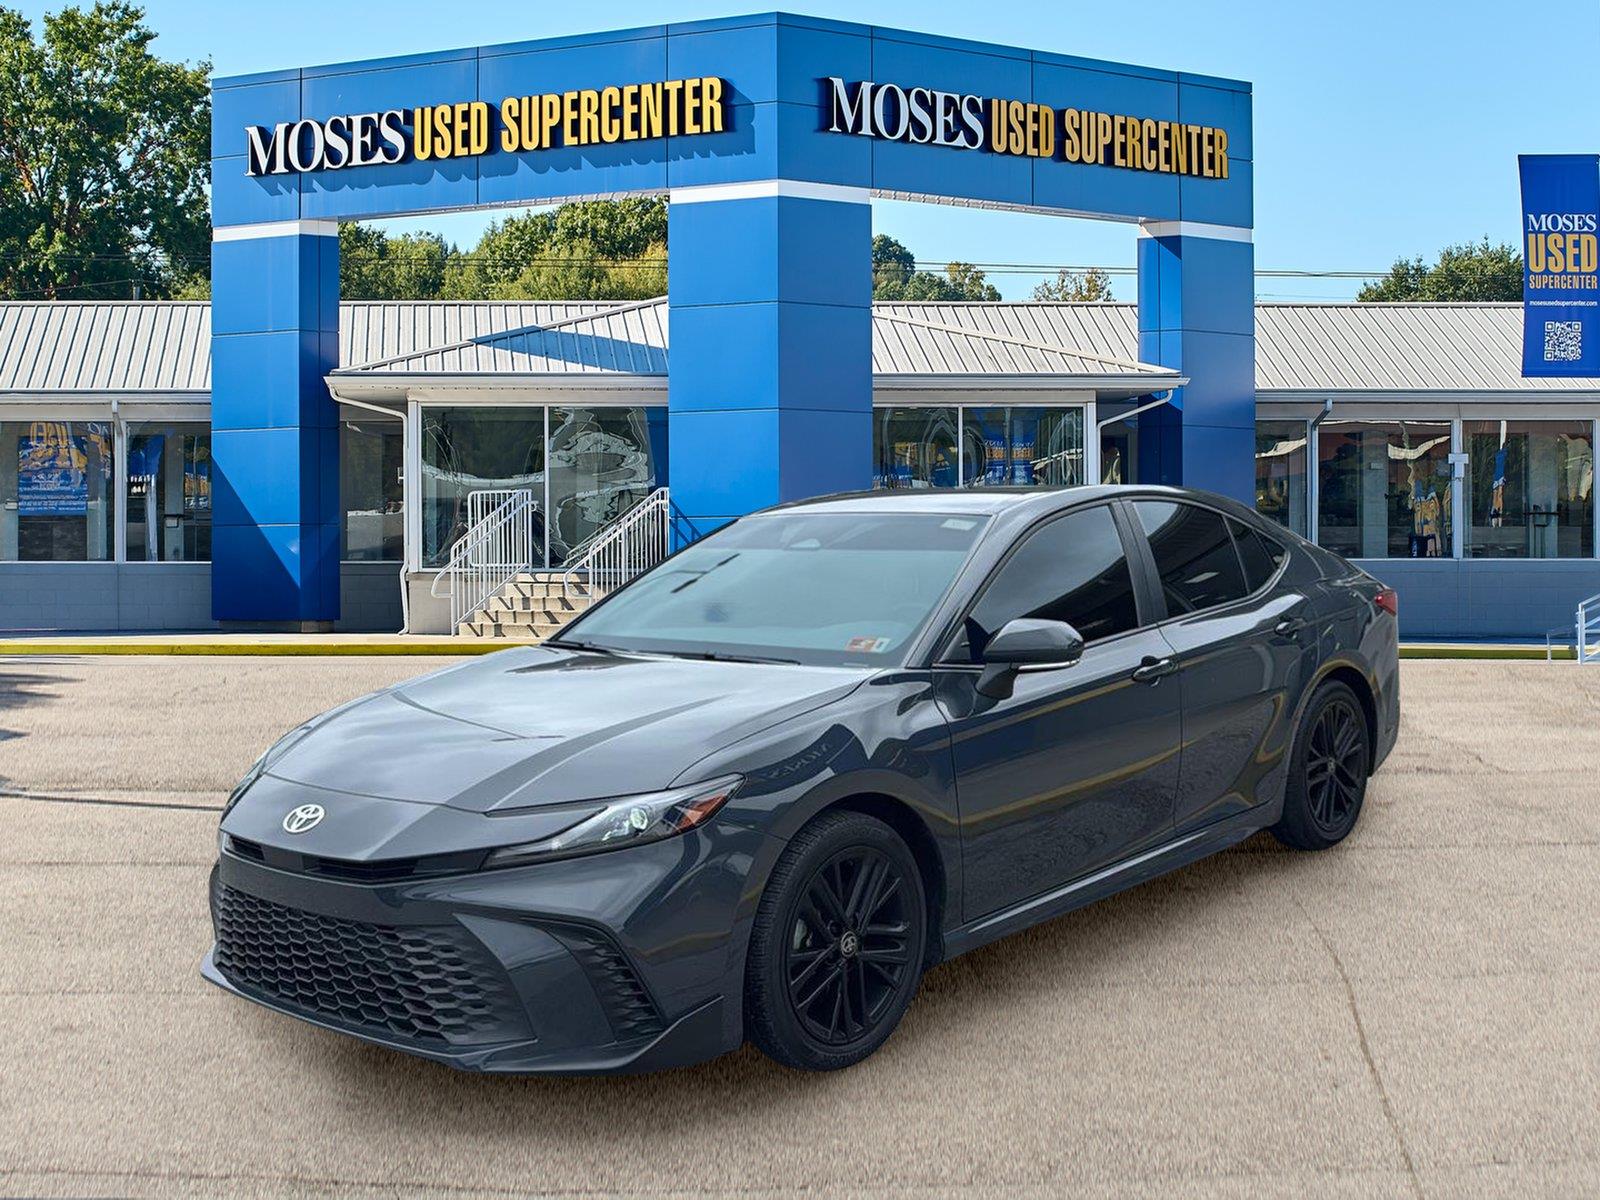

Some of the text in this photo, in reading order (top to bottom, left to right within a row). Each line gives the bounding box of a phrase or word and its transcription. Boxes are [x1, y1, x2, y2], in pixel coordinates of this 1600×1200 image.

[244, 76, 725, 176] MOSES USED SUPERCENTER
[828, 76, 1229, 179] MOSES USED SUPERCENTER
[1527, 213, 1597, 232] MOSES
[1528, 233, 1598, 273] USED
[1529, 275, 1598, 289] SUPERCENTER
